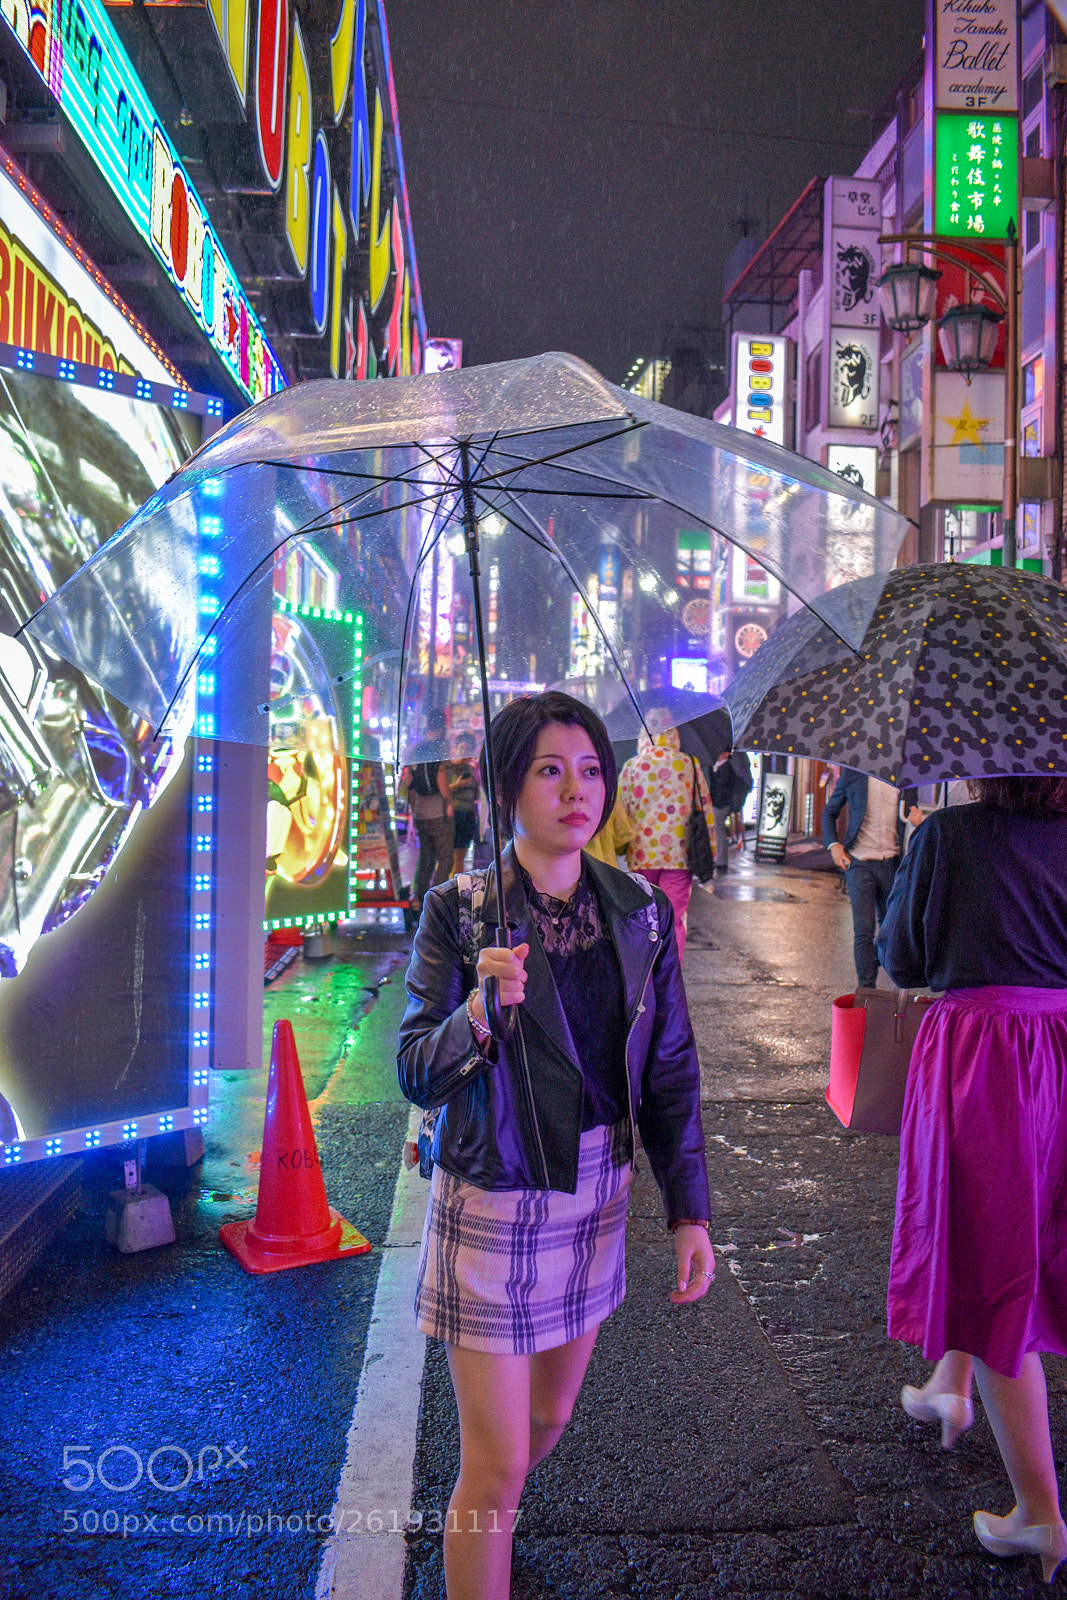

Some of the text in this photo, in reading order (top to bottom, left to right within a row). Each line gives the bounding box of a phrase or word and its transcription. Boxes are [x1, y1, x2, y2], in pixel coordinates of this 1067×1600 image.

[942, 0, 997, 13] Kikuko
[953, 17, 1008, 35] Tanaka
[942, 39, 1010, 71] Ballet
[948, 76, 1008, 104] academy
[965, 96, 988, 107] 3F
[966, 121, 987, 234] 歌舞伎市場
[862, 313, 878, 326] 3F
[748, 341, 774, 423] ROBOT
[861, 414, 876, 426] 2F
